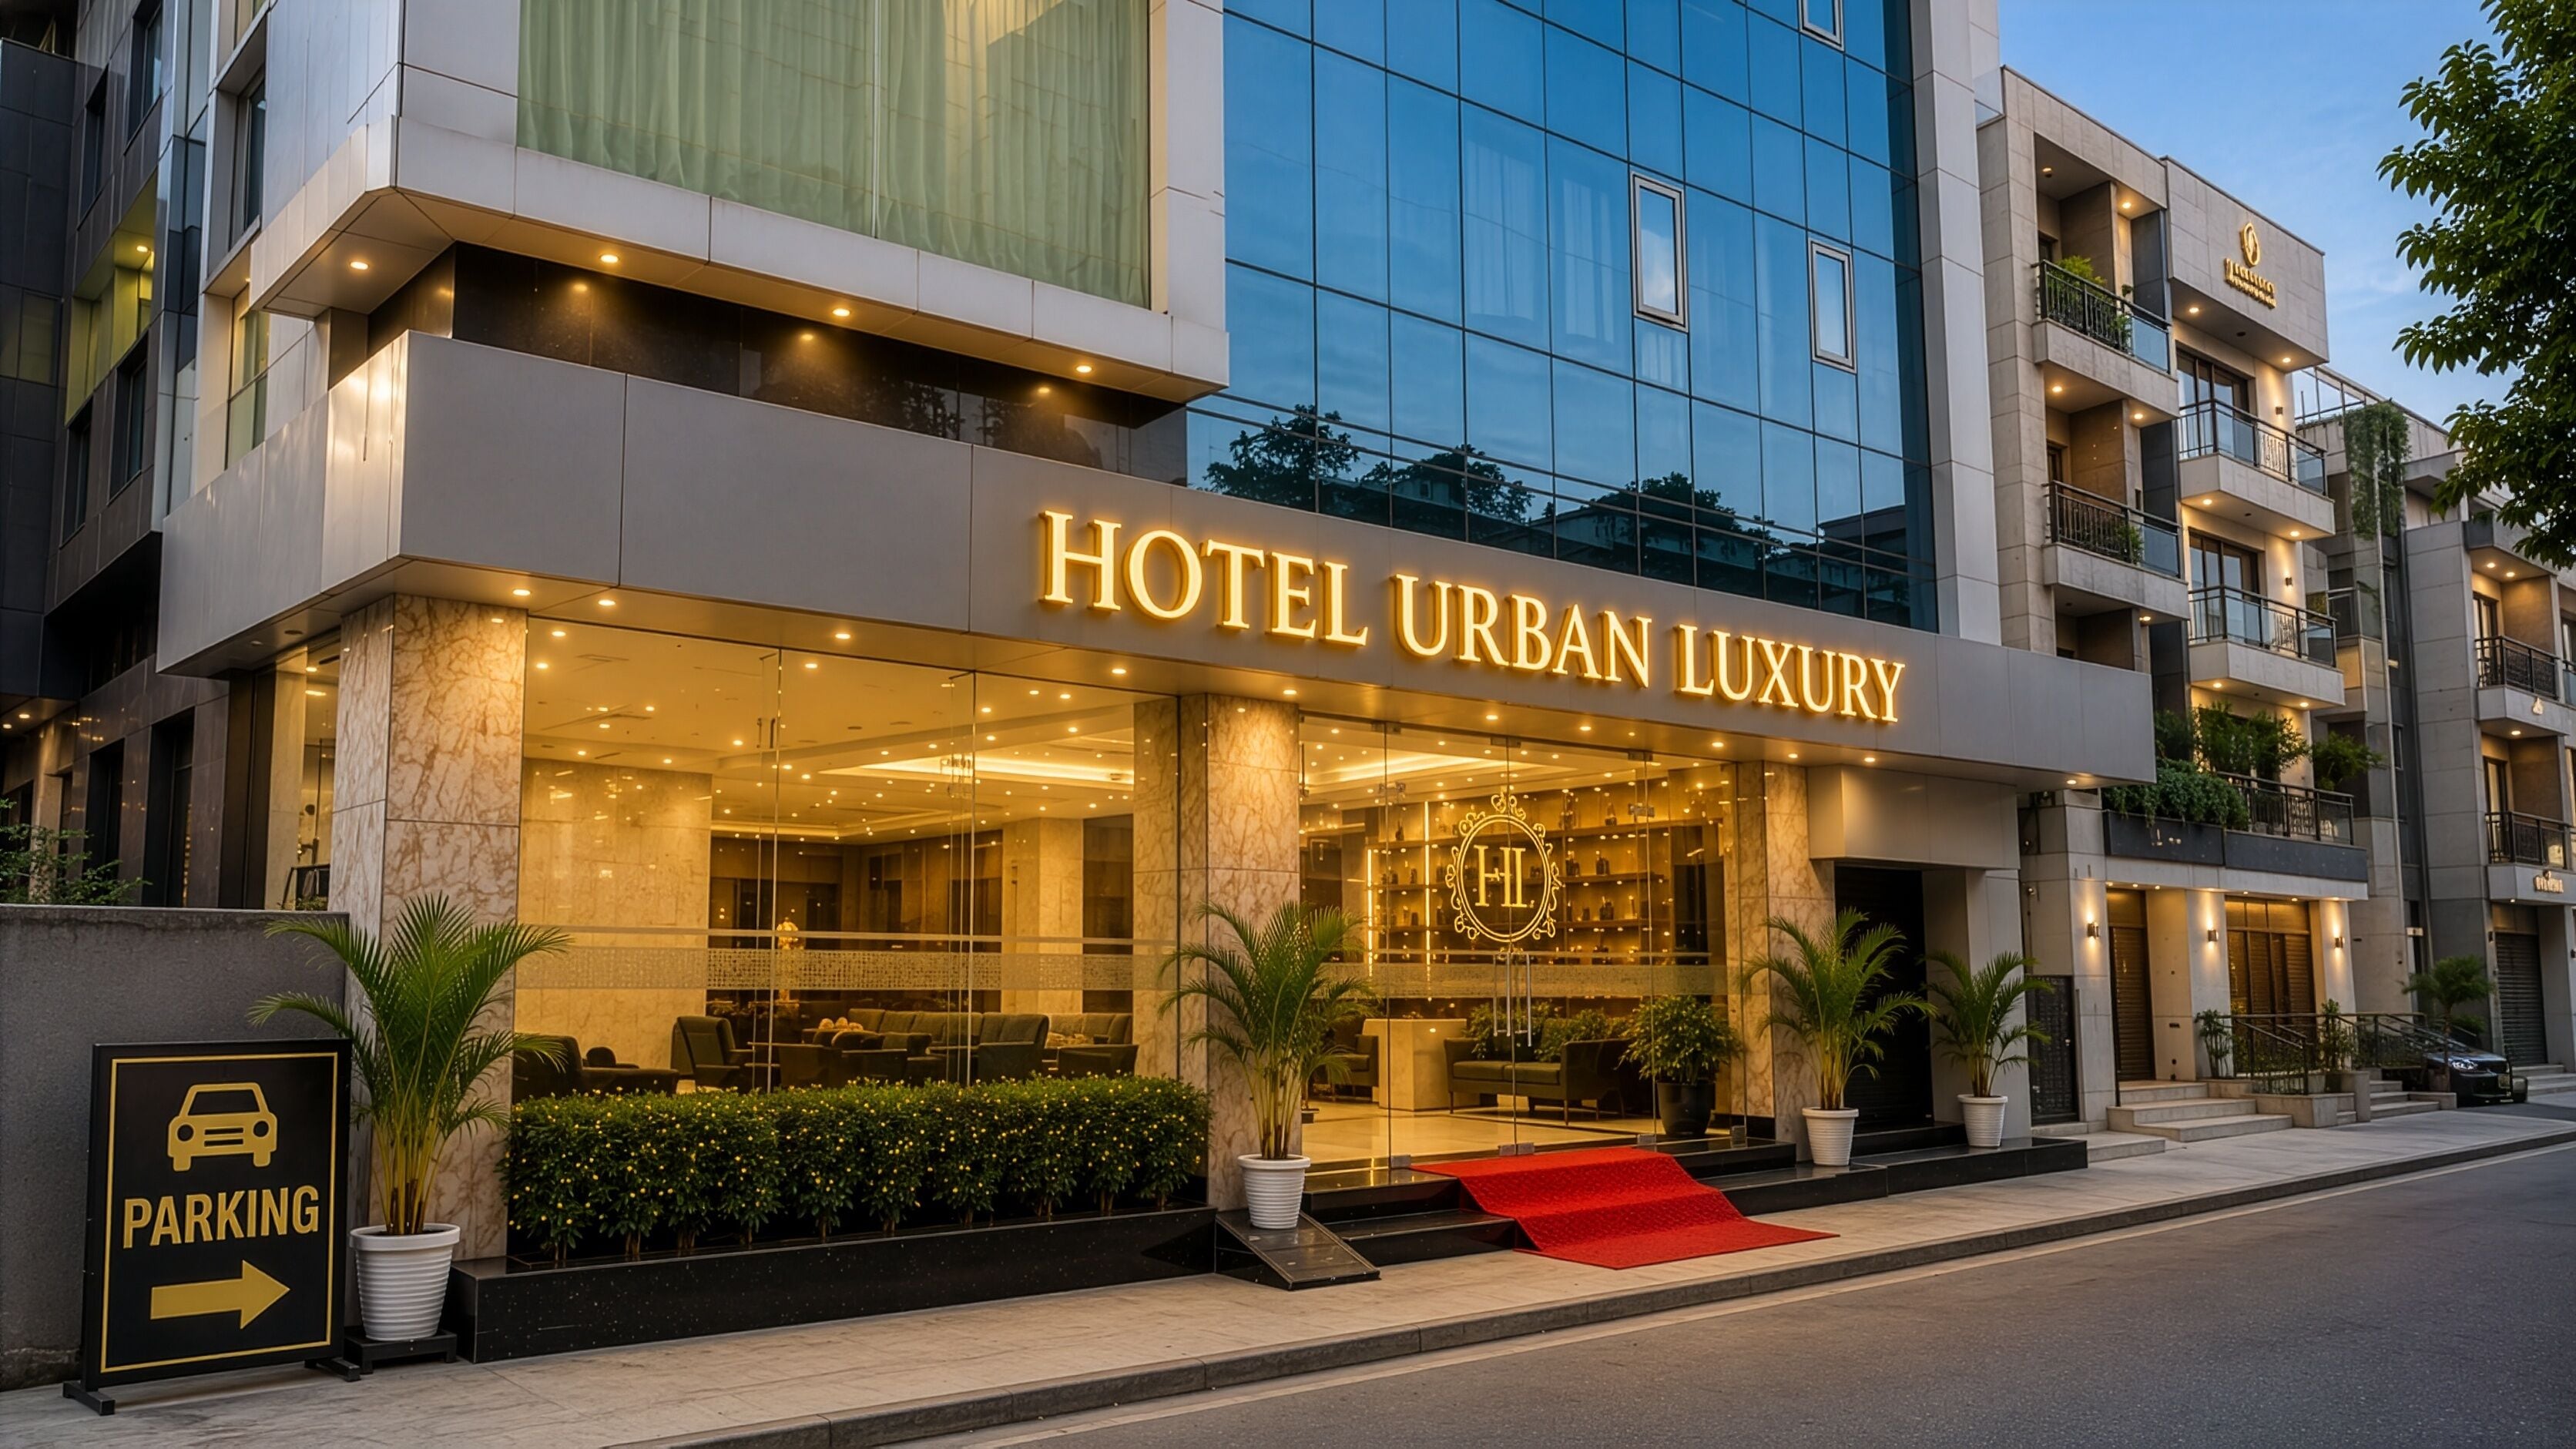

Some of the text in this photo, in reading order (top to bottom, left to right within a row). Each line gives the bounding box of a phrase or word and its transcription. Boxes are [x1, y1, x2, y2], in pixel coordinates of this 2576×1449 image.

[1040, 510, 1905, 723] HOTEL URBAN LUXURY
[123, 1185, 319, 1249] PARKING
